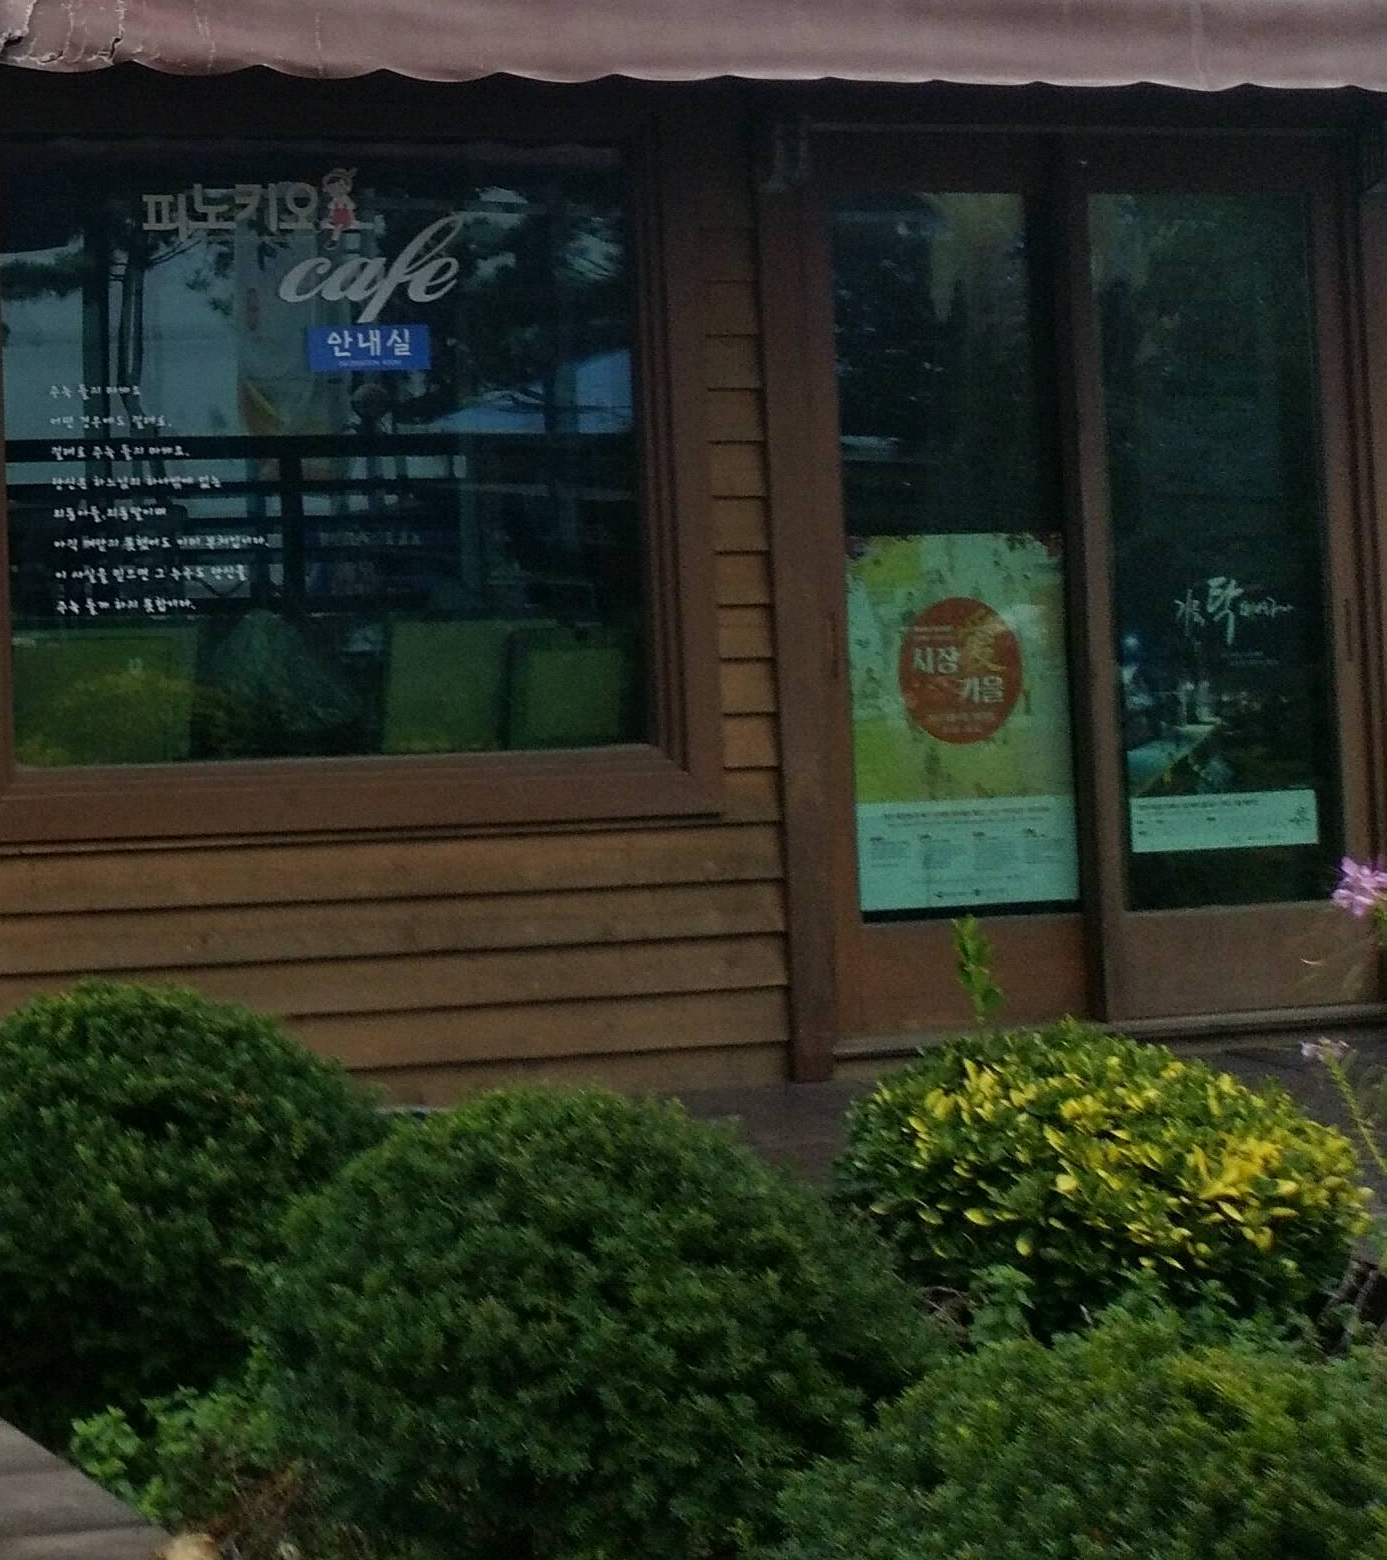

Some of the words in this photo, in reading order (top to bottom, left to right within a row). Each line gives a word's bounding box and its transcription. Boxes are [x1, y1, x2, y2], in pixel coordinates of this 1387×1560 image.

[142, 181, 317, 240] 피노키오
[279, 211, 464, 323] cafe
[327, 328, 412, 357] 안내실
[154, 568, 166, 578] 그
